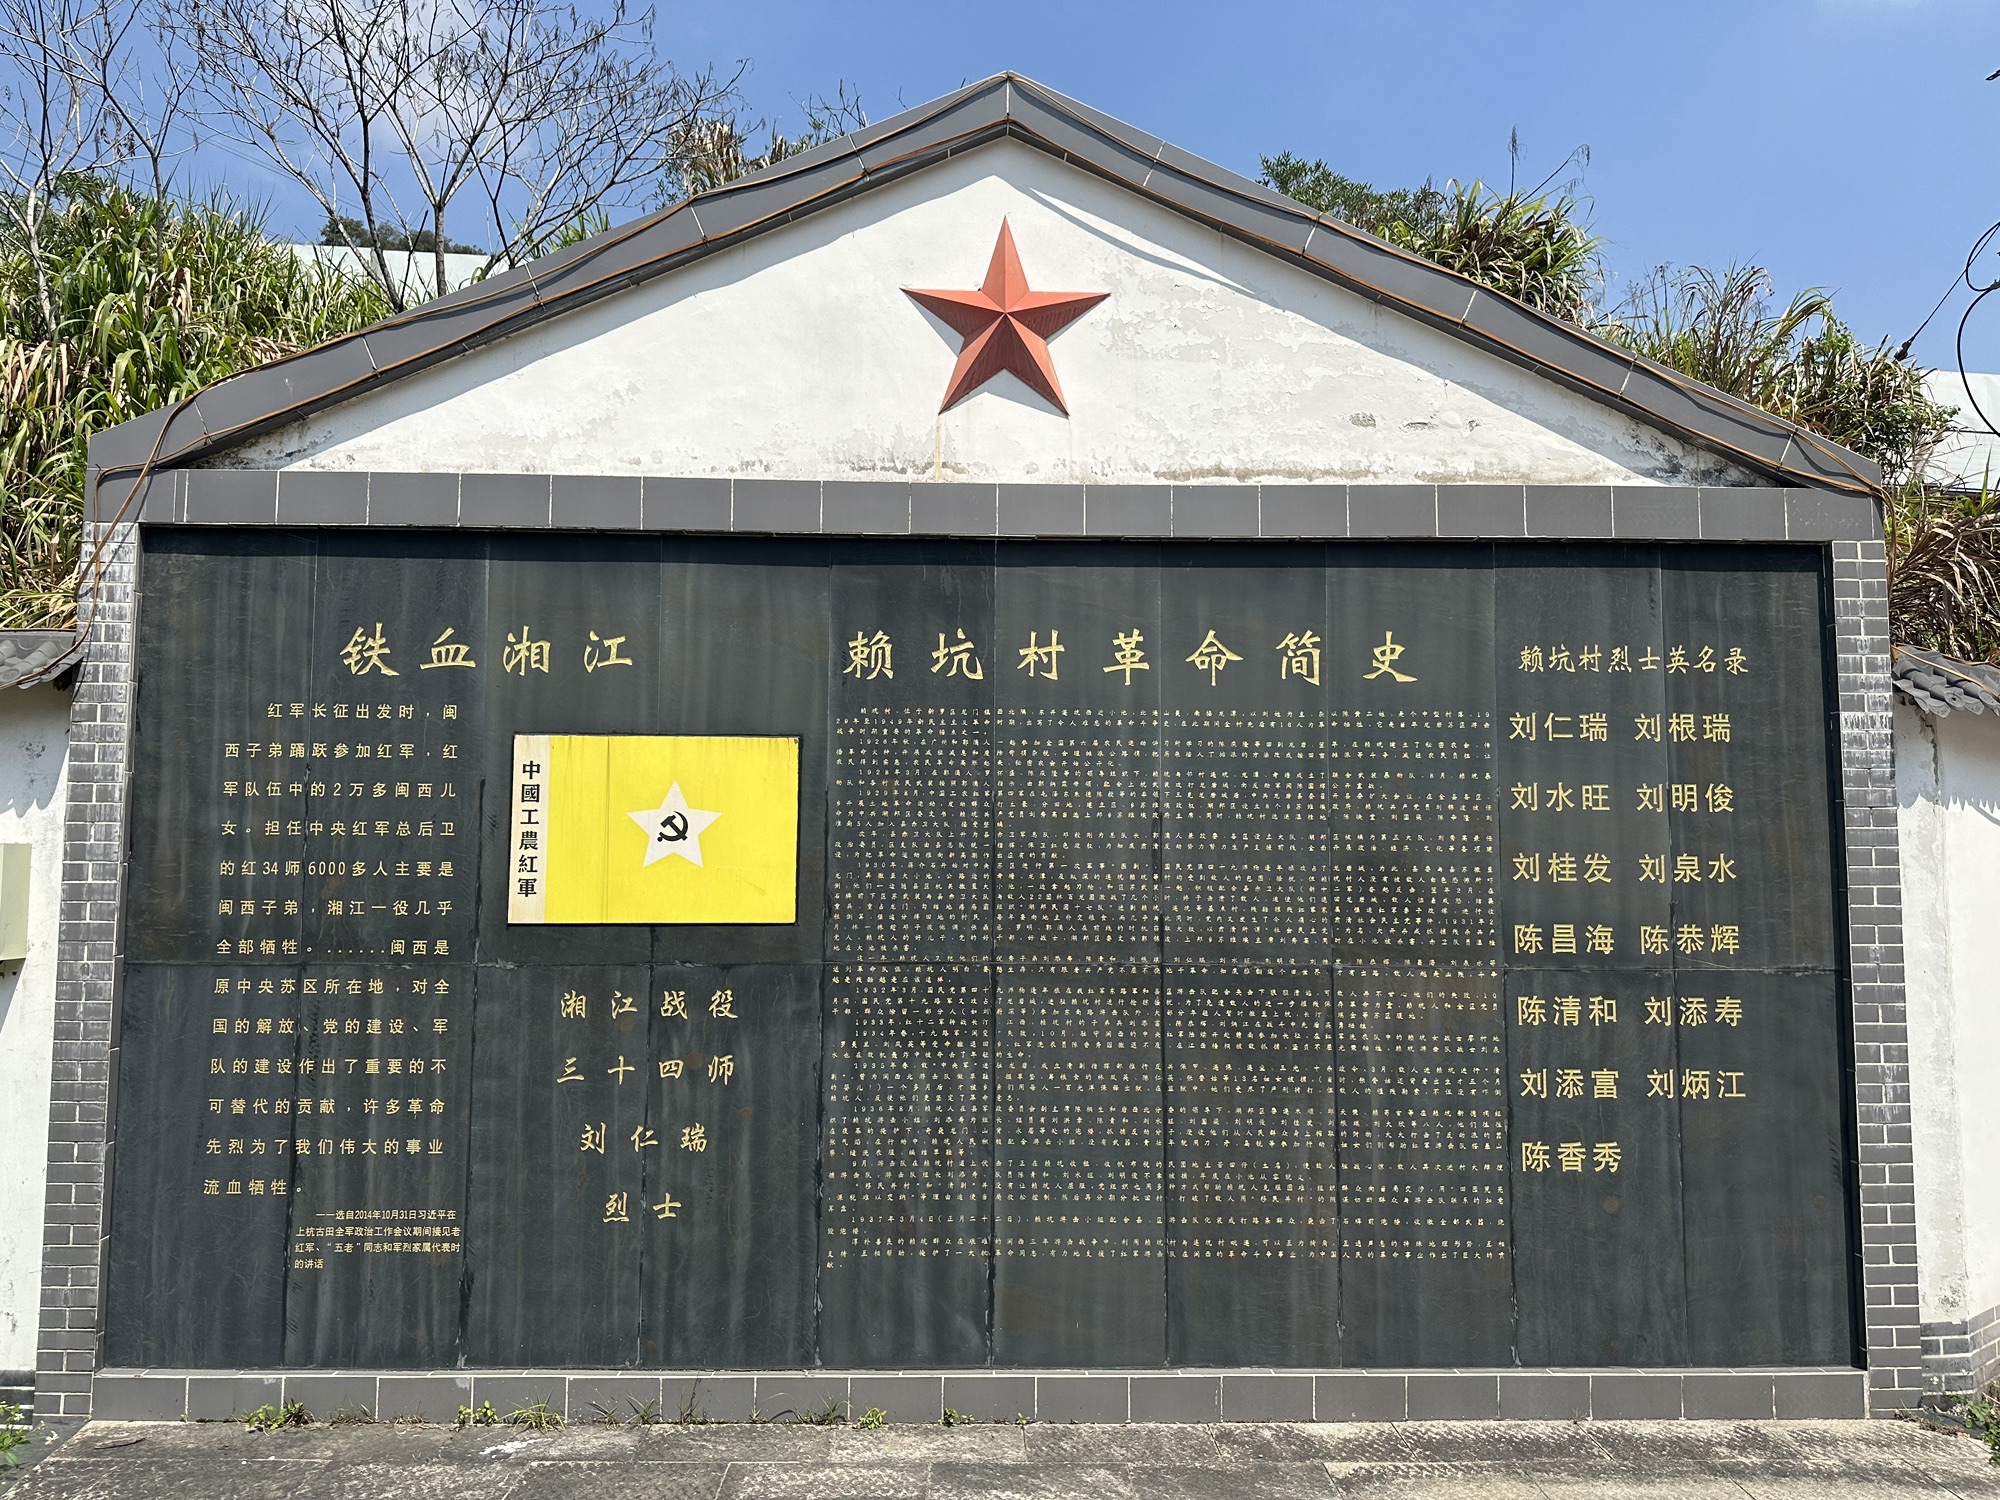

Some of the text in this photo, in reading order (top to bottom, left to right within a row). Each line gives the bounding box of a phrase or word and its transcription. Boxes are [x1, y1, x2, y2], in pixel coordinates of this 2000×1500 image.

[339, 622, 634, 676] 铁血湘江
[842, 627, 1418, 687] 赖坑村革命简史
[1518, 643, 1749, 676] 赖坑村烈士英名录
[267, 702, 458, 720] 红军长征出发时，闽
[1508, 711, 1732, 743] 刘仁瑞 刘根瑞
[224, 741, 458, 759] 西子弟踊跃参加红军，红
[222, 780, 457, 798] 军队伍中的2万多闽西儿
[1510, 780, 1735, 813] 刘水旺 刘明俊
[220, 819, 455, 837] 女。担任中央红军总后卫
[517, 760, 541, 898] 中國工農紅軍
[219, 859, 454, 877] 的红34师6000多人主要是
[1512, 852, 1737, 884] 刘桂发 刘泉水
[218, 899, 453, 916] 闽西子弟，湘江一役几乎
[1514, 923, 1740, 955] 陈昌海 陈恭辉
[213, 977, 450, 995] 原中央苏区所在地，对全
[560, 989, 739, 1020] 湘江战役
[1517, 995, 1743, 1027] 陈清和 刘添寿
[212, 1017, 448, 1035] 国的解放、党的建设、军
[210, 1057, 447, 1075] 队的建设作出了重要的不
[556, 1054, 735, 1086] 三十四师
[1519, 1067, 1747, 1100] 刘添富 刘炳江
[208, 1097, 445, 1115] 可替代的贡献，许多革命
[205, 1137, 444, 1155] 先烈为了我们伟大的事业
[579, 1121, 708, 1155] 刘仁瑞
[1521, 1140, 1623, 1173] 陈香秀
[203, 1178, 302, 1196] 流血牺牲。
[602, 1191, 682, 1223] 烈士
[293, 1258, 324, 1270] 的讲话
